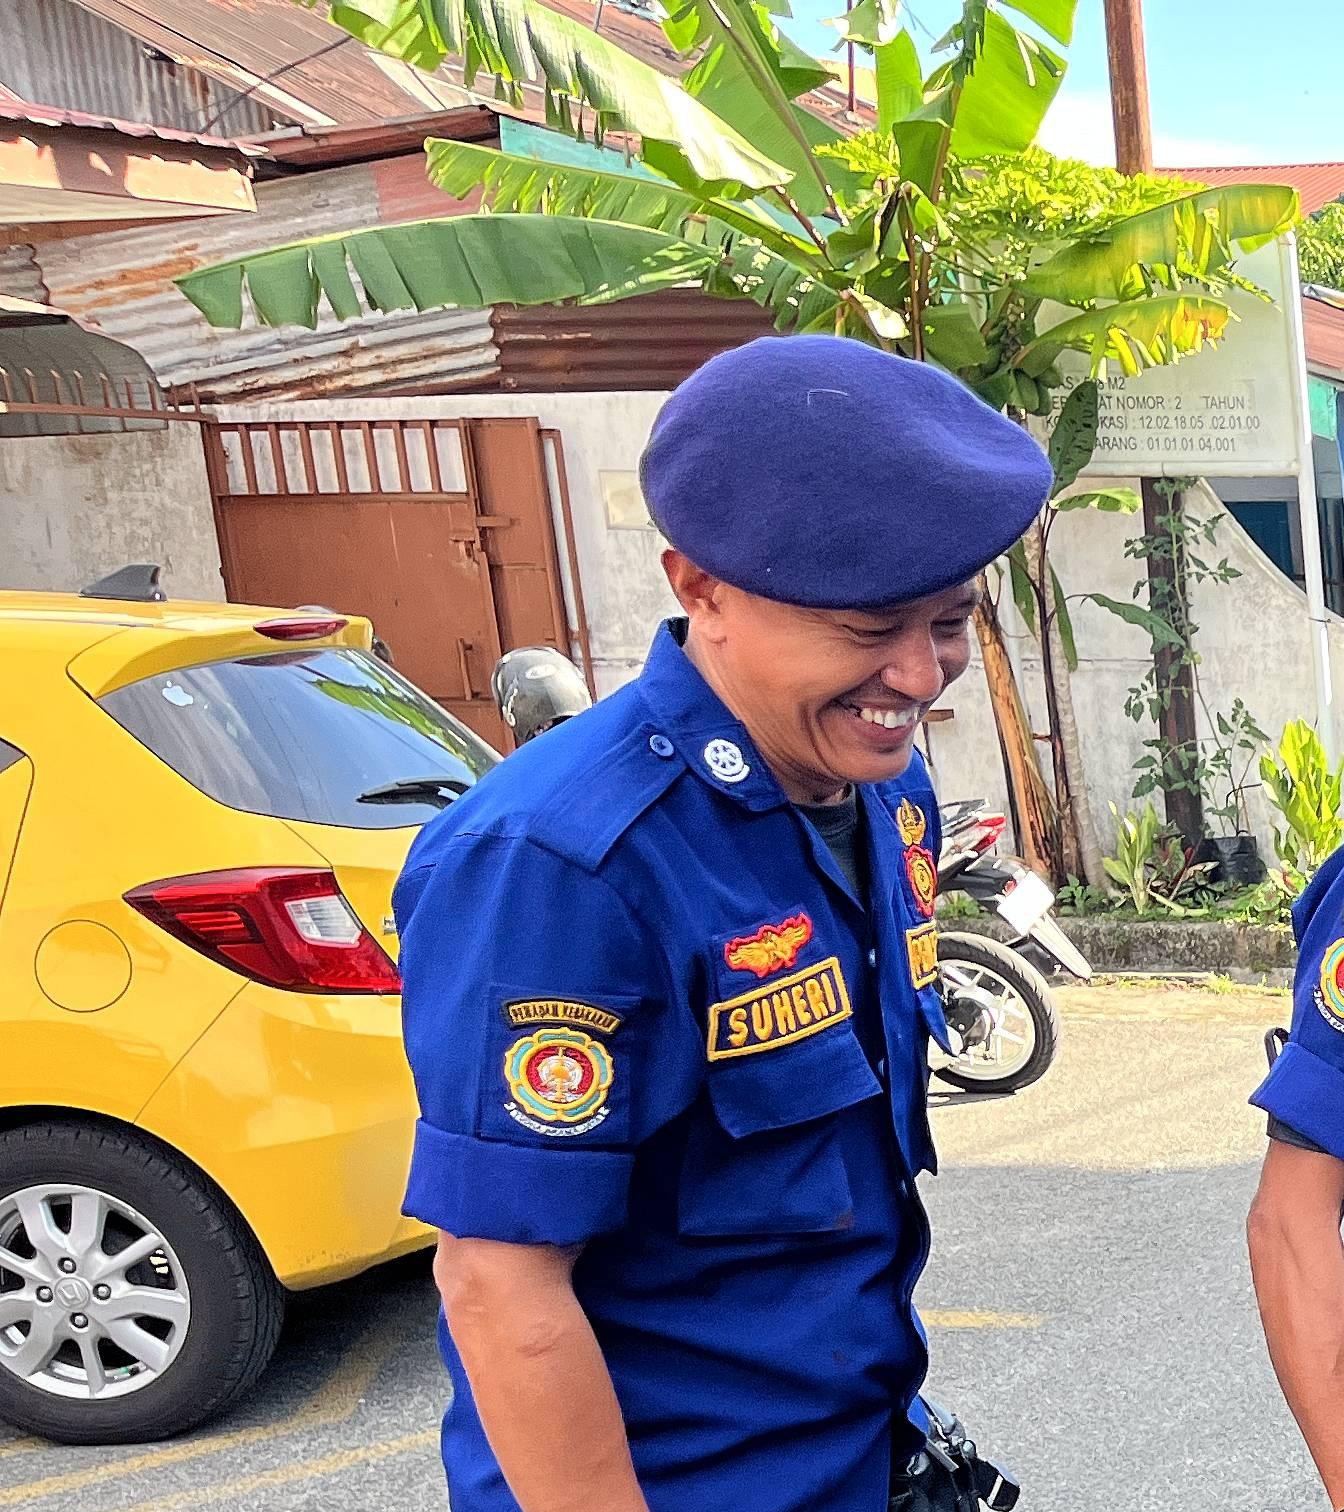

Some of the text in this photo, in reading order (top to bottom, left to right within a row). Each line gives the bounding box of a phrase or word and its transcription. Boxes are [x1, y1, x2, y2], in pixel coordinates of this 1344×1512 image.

[1116, 395, 1165, 410] NOMOR
[1202, 395, 1246, 410] TAHUN
[1095, 437, 1138, 451] ARANG
[728, 972, 840, 1047] SUHERI
